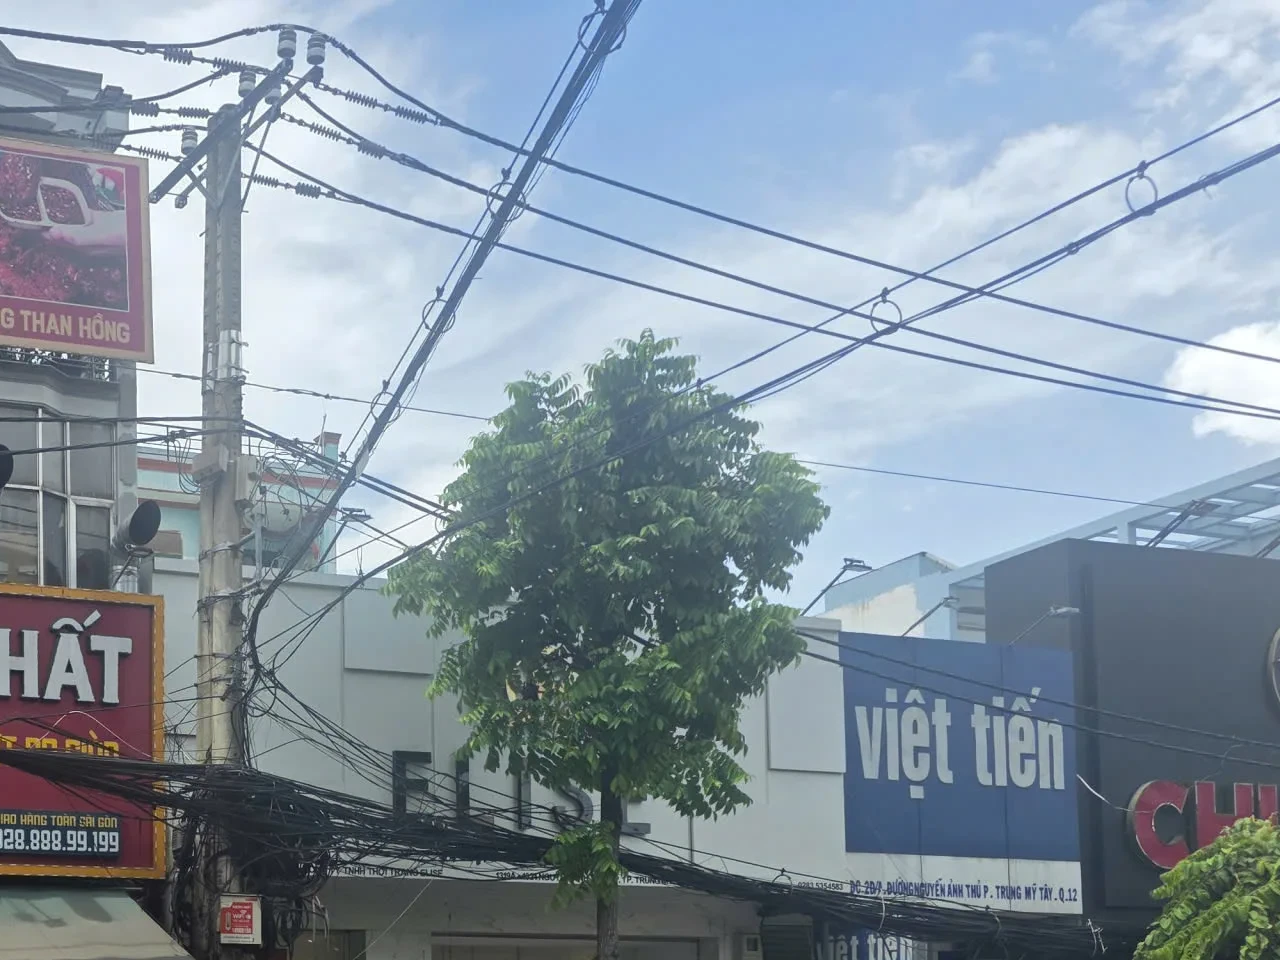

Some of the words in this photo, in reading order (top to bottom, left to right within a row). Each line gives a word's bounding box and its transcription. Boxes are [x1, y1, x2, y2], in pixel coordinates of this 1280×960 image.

[20, 309, 72, 337] THAN
[78, 312, 131, 343] HỒNG
[854, 687, 954, 799] việt
[970, 686, 1066, 790] tiến
[21, 812, 47, 826] HÀNG
[52, 813, 77, 827] TOÀN
[98, 815, 118, 829] GÒN
[995, 888, 1022, 900] TRUNG
